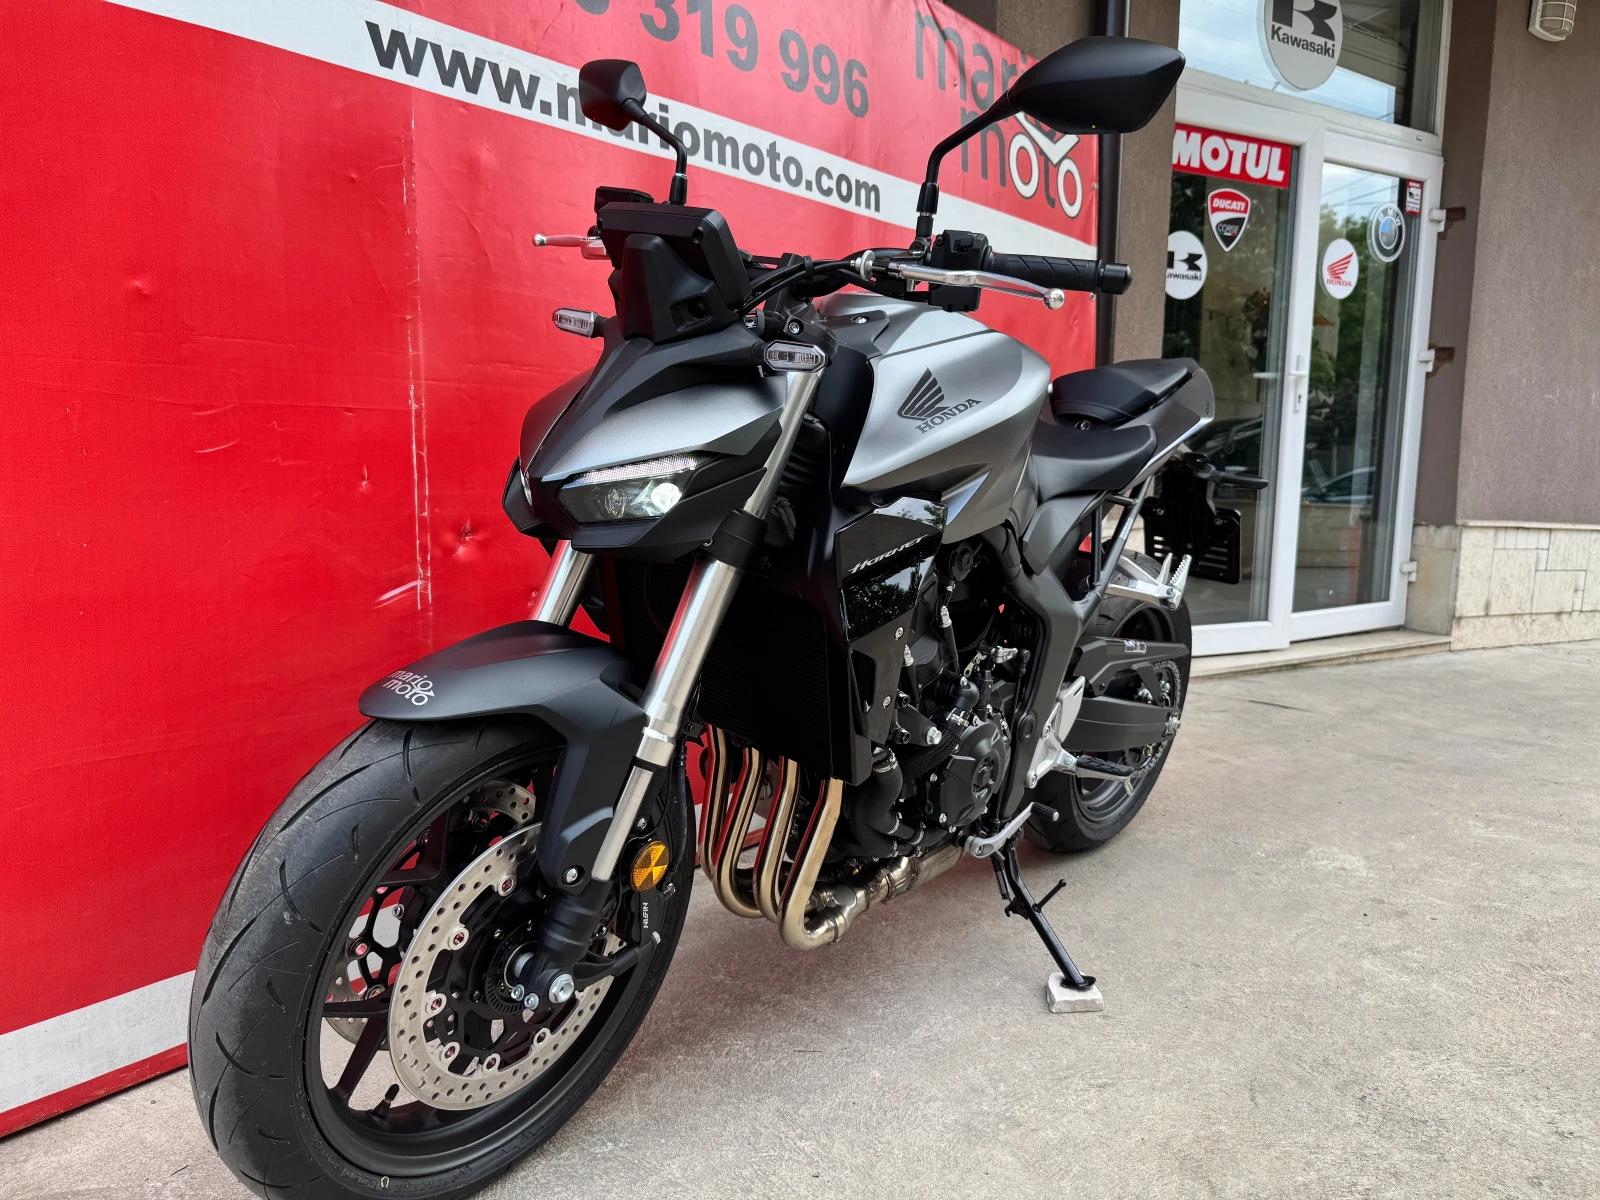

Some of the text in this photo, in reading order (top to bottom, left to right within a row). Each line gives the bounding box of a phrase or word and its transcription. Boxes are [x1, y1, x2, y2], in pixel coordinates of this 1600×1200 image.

[1271, 24, 1335, 58] Kawasaki
[640, 0, 869, 118] 319 996
[1172, 130, 1285, 182] MOTUL
[1213, 198, 1245, 211] DUCATI
[1217, 224, 1239, 234] CORSE
[1167, 272, 1202, 281] awasaki
[1326, 279, 1352, 287] HONDA
[915, 398, 982, 434] HONDA
[382, 679, 428, 706] moto
[388, 670, 433, 691] mario
